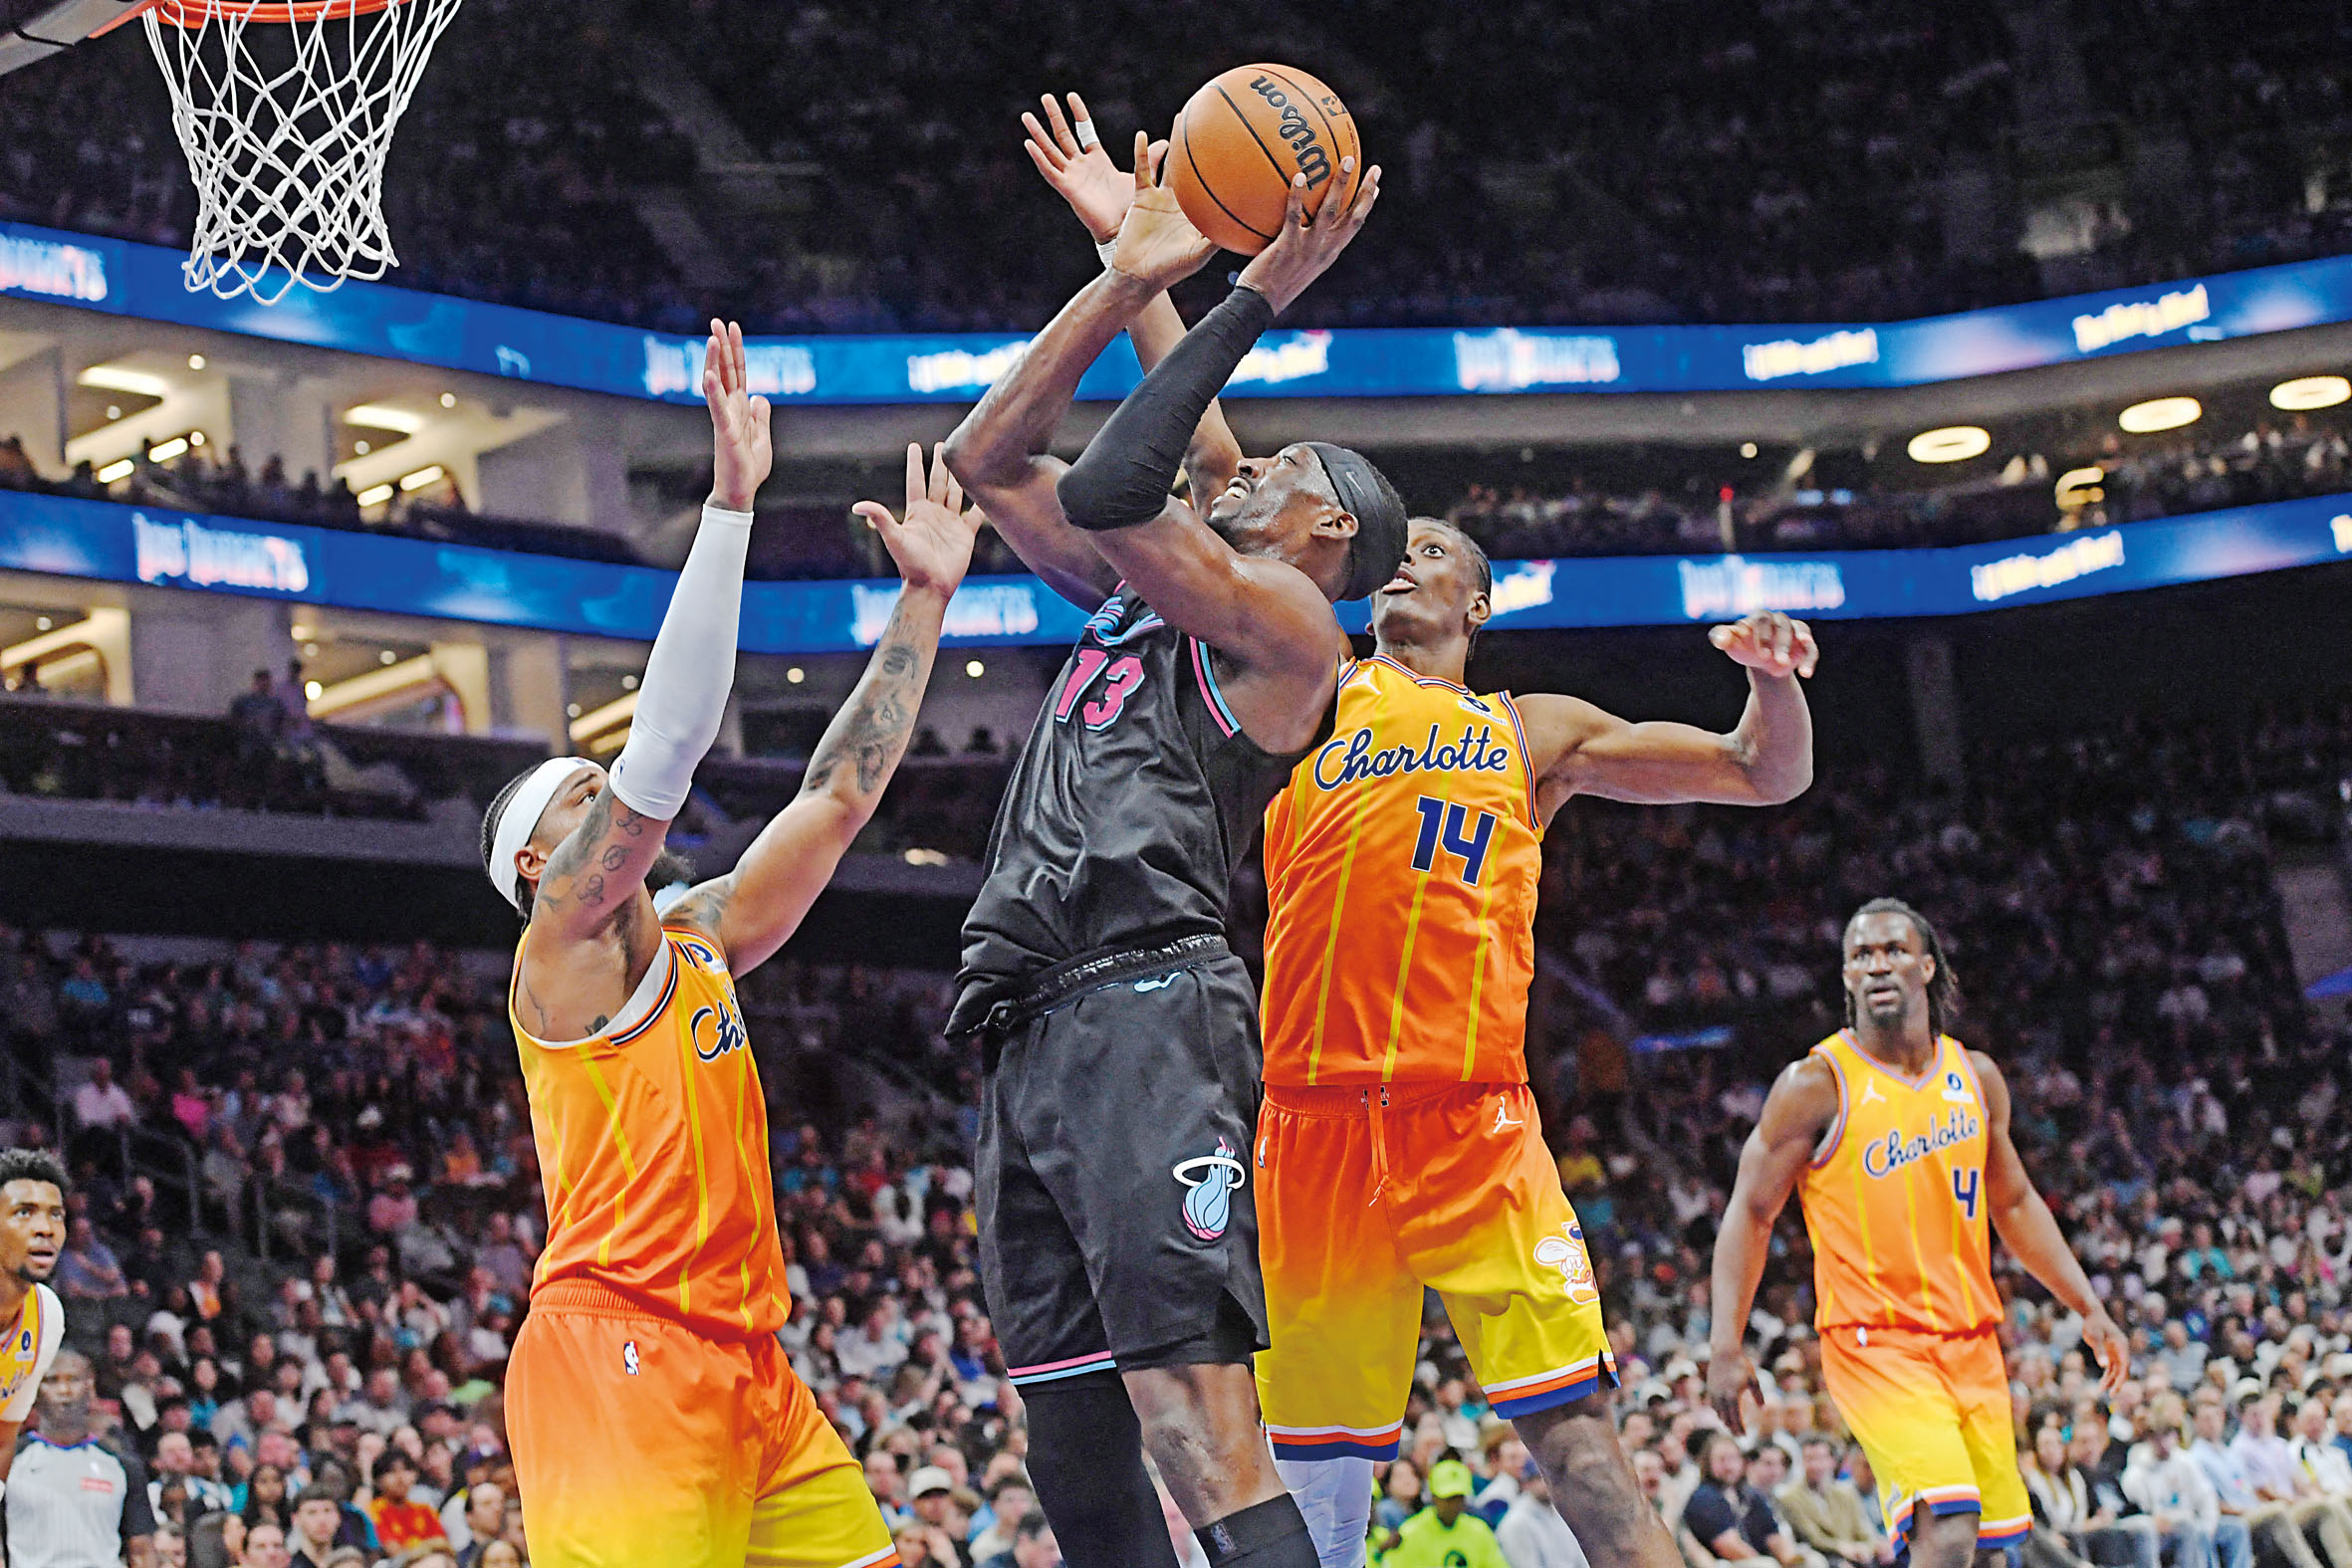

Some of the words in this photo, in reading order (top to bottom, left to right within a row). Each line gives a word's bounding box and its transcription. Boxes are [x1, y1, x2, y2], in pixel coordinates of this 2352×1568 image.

[1250, 75, 1331, 192] Wilson
[1055, 649, 1145, 732] 13
[1314, 723, 1509, 791] Charlotte
[1410, 794, 1498, 886] 14
[1864, 1105, 1979, 1179] Charlotte
[1953, 1168, 1979, 1218] 4
